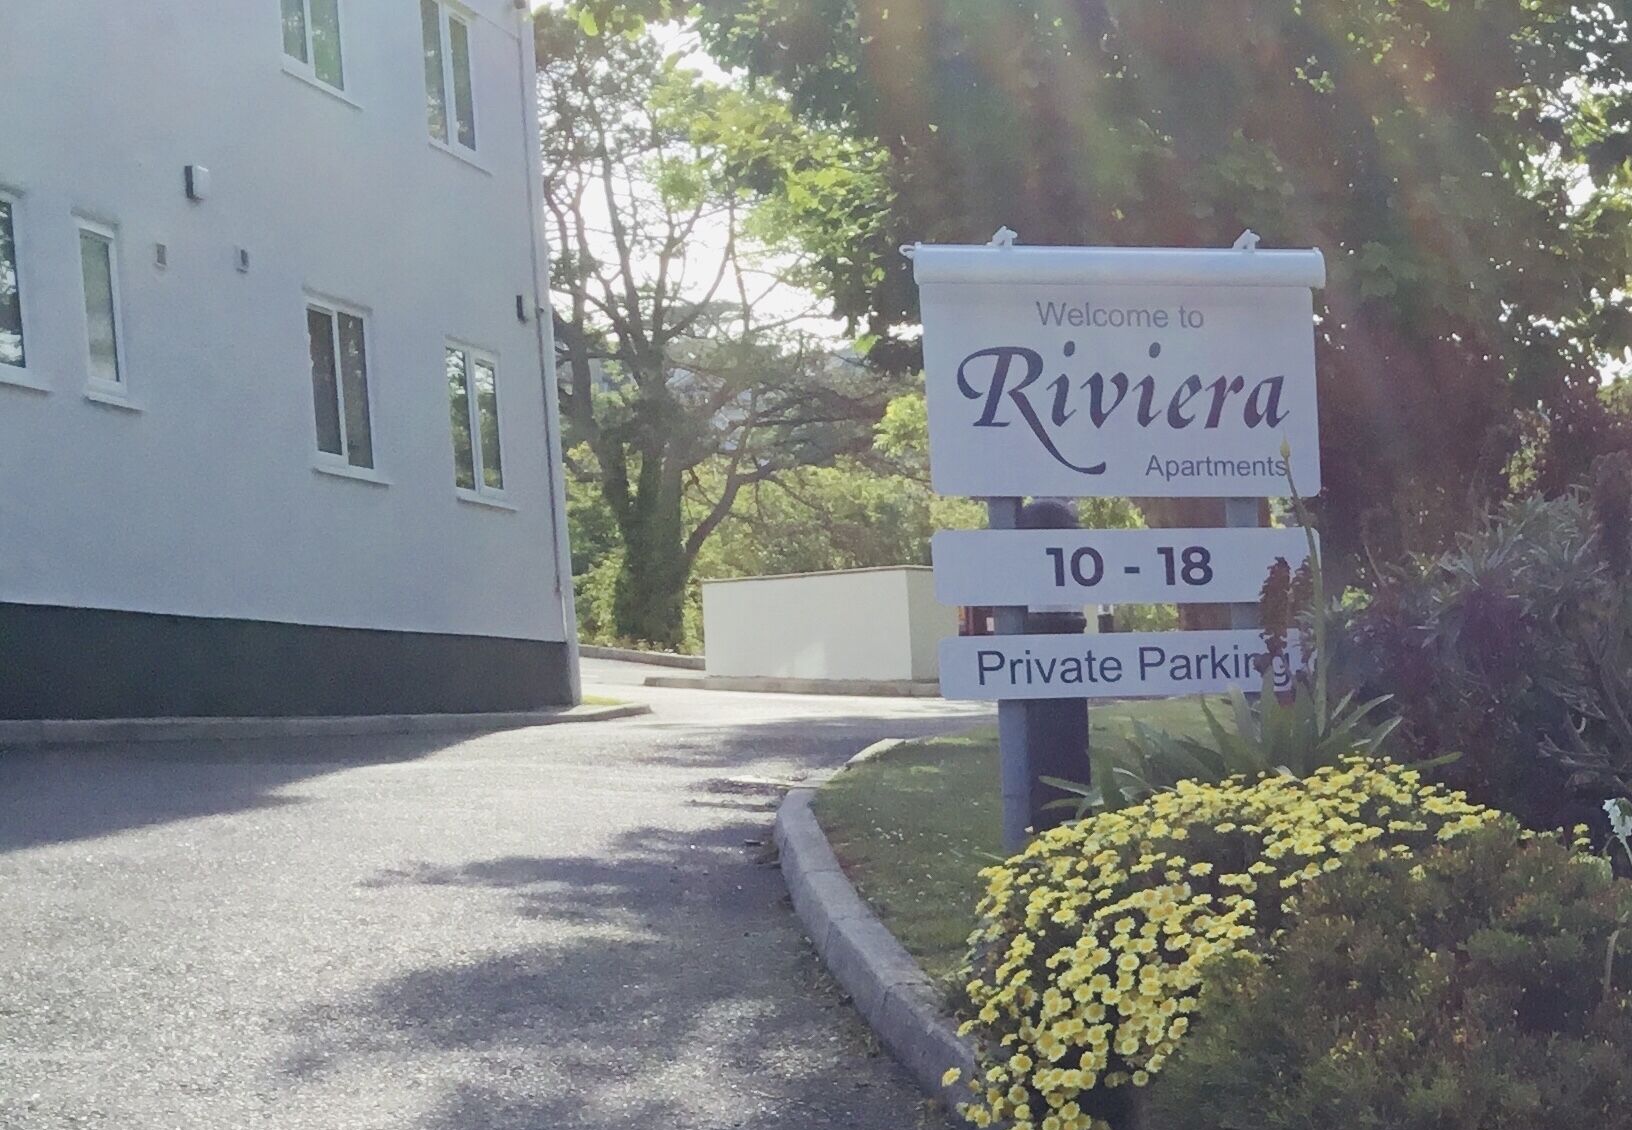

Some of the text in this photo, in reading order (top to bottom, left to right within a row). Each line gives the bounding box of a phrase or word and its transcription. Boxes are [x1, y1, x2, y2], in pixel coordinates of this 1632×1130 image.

[1036, 302, 1205, 329] Welcome to
[957, 341, 1290, 475] Riviera
[1145, 455, 1288, 482] Apartments
[1046, 546, 1213, 587] 10 - 18
[977, 649, 1122, 686] Private
